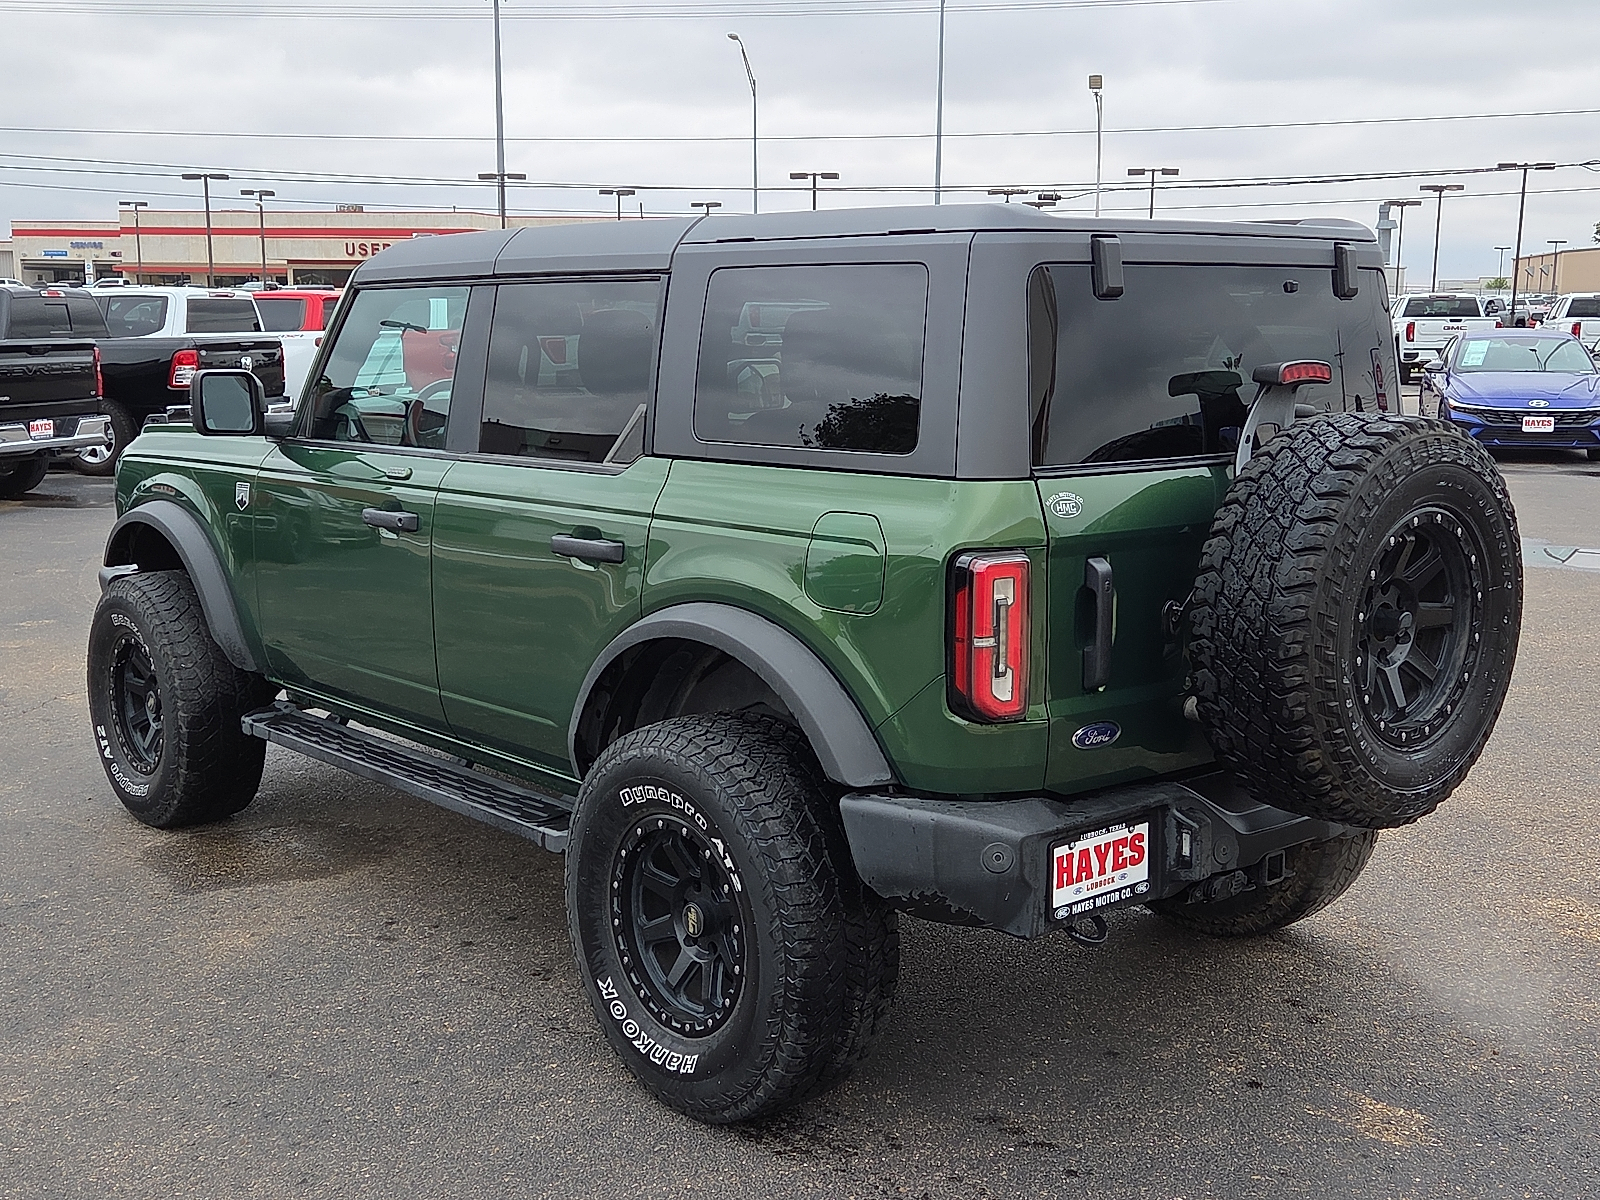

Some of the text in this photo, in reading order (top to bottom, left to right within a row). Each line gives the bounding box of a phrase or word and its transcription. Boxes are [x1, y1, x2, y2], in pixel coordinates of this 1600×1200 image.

[30, 422, 52, 432] HAYES
[1524, 419, 1552, 427] HAYES
[619, 785, 708, 830] Dynapro
[1109, 823, 1126, 833] TEXAS
[1055, 832, 1146, 890] HAYES
[1086, 876, 1116, 892] LUBBOCK
[1072, 899, 1094, 914] HAYES
[1095, 892, 1120, 908] MOTOR
[1121, 888, 1133, 899] CO.
